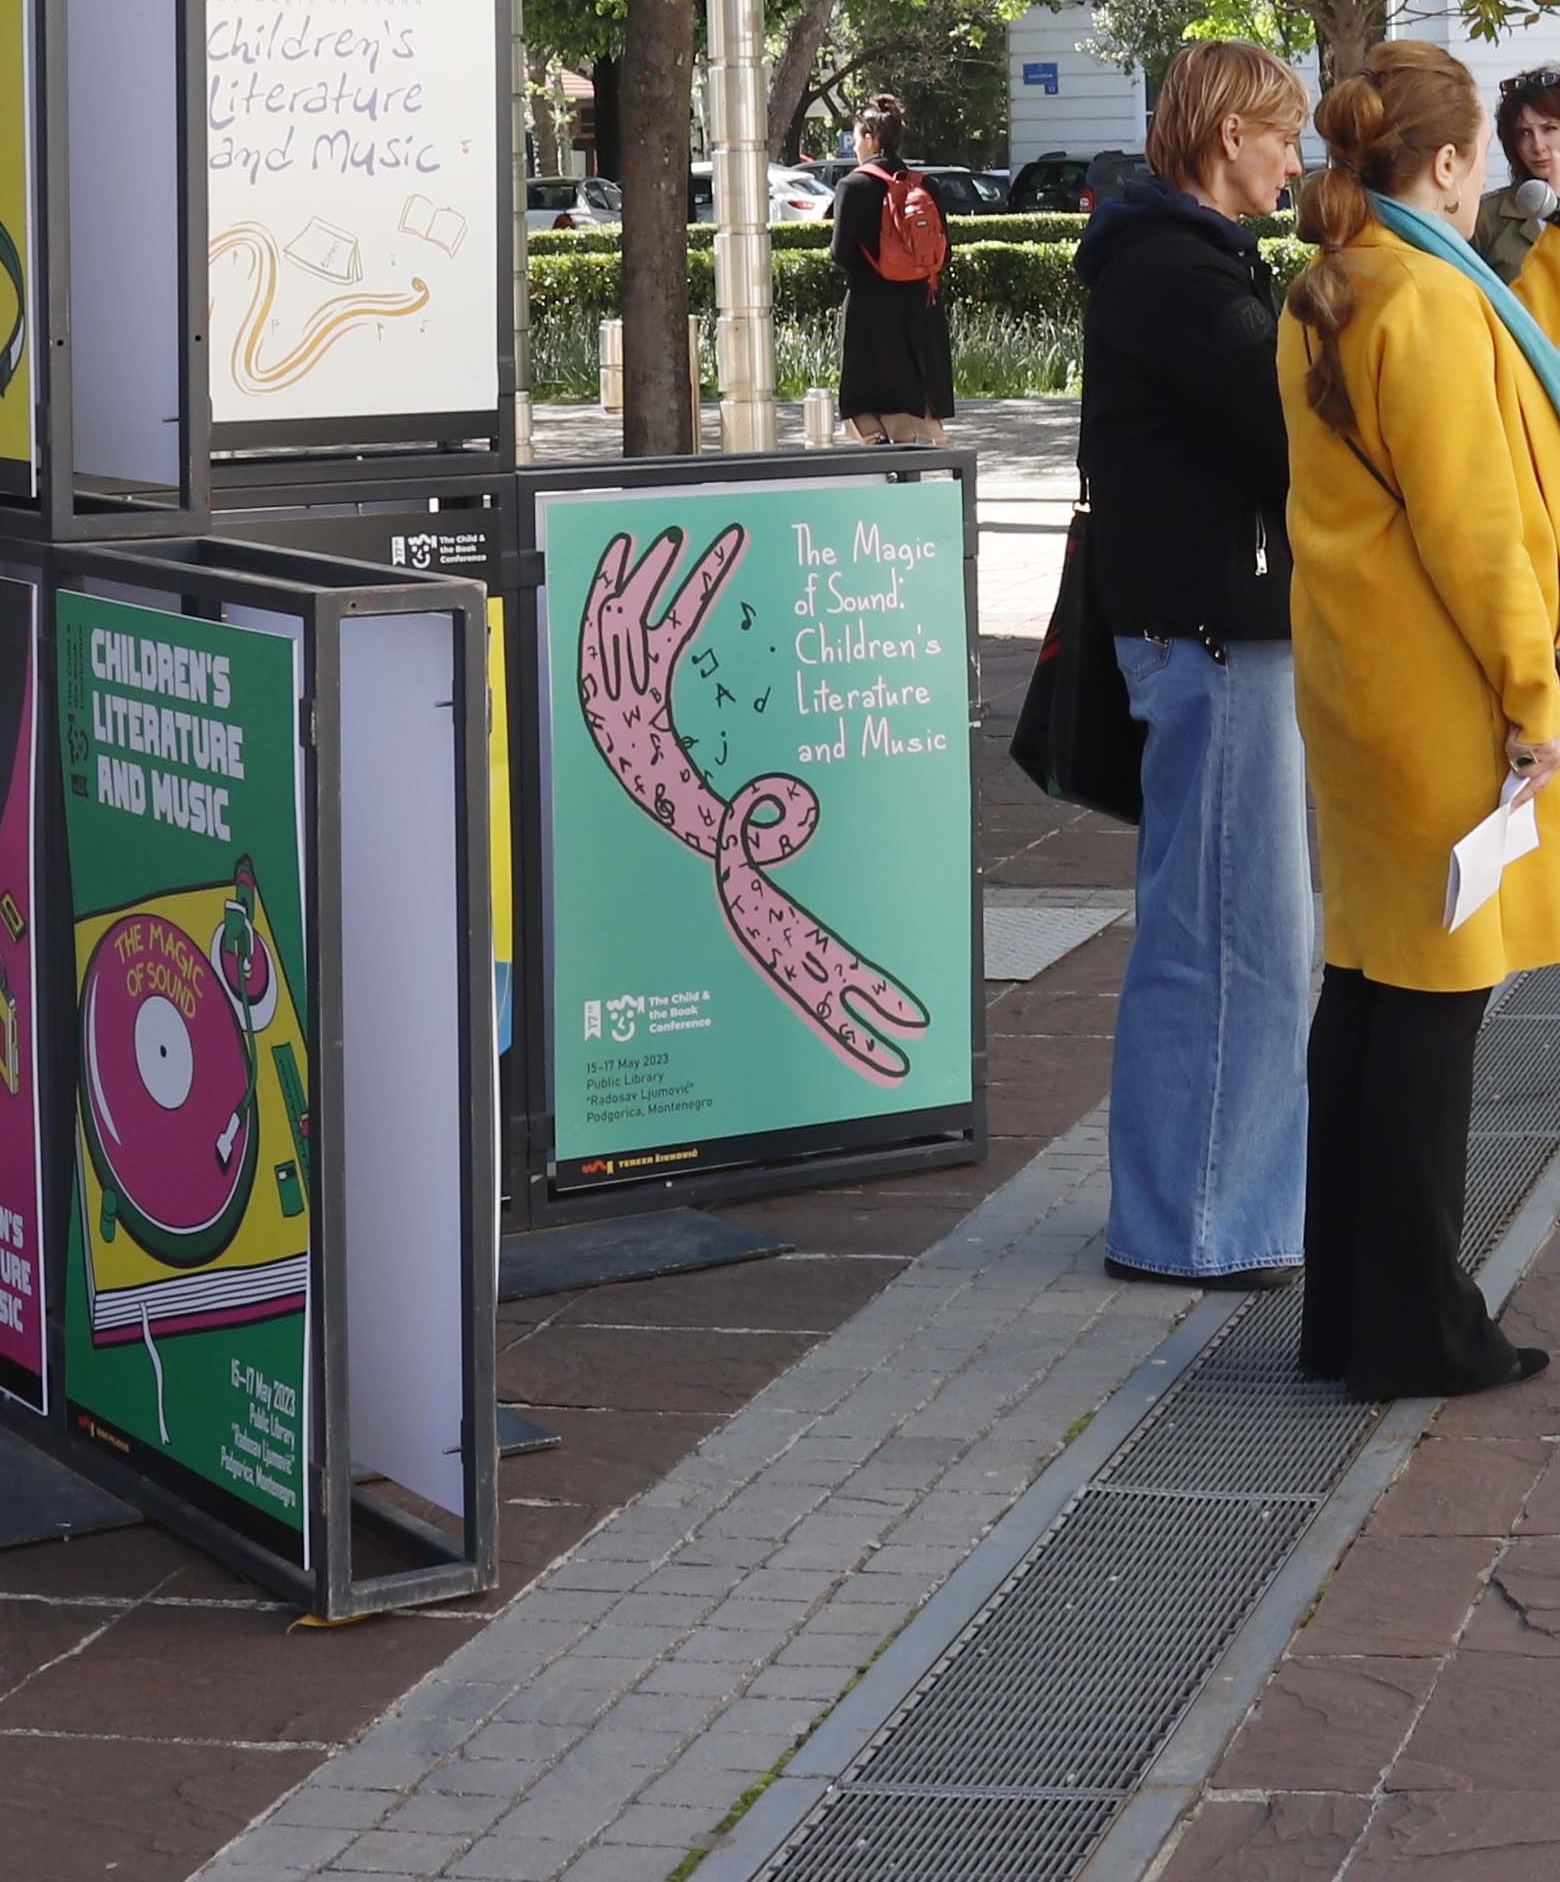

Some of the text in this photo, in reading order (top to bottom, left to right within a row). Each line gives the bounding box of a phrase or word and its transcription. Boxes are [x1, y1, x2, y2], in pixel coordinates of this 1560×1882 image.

[206, 12, 415, 75] Children's
[208, 70, 424, 131] Literature
[208, 125, 441, 186] and Music
[791, 519, 936, 571] The Magic
[794, 567, 905, 618] of Sound:
[795, 618, 942, 665] Children's
[91, 627, 232, 710] CHILDREN'S
[796, 669, 932, 715] Literature
[92, 689, 245, 781] LITERATURE
[798, 714, 947, 764] and Music
[97, 753, 232, 843] AND MUSIC
[113, 921, 205, 999] THE MAGIC
[126, 961, 197, 1020] OF SOUND
[648, 996, 670, 1007] The
[671, 991, 699, 1004] Child
[648, 1005, 699, 1020] the Book
[648, 1017, 712, 1034] Conference
[586, 1071, 665, 1091] Public Library
[617, 1058, 641, 1072] May
[643, 1053, 670, 1067] 2023
[586, 1097, 713, 1124] Podgorica, Montenegro
[255, 1370, 272, 1411] May
[273, 1380, 297, 1418] 2023
